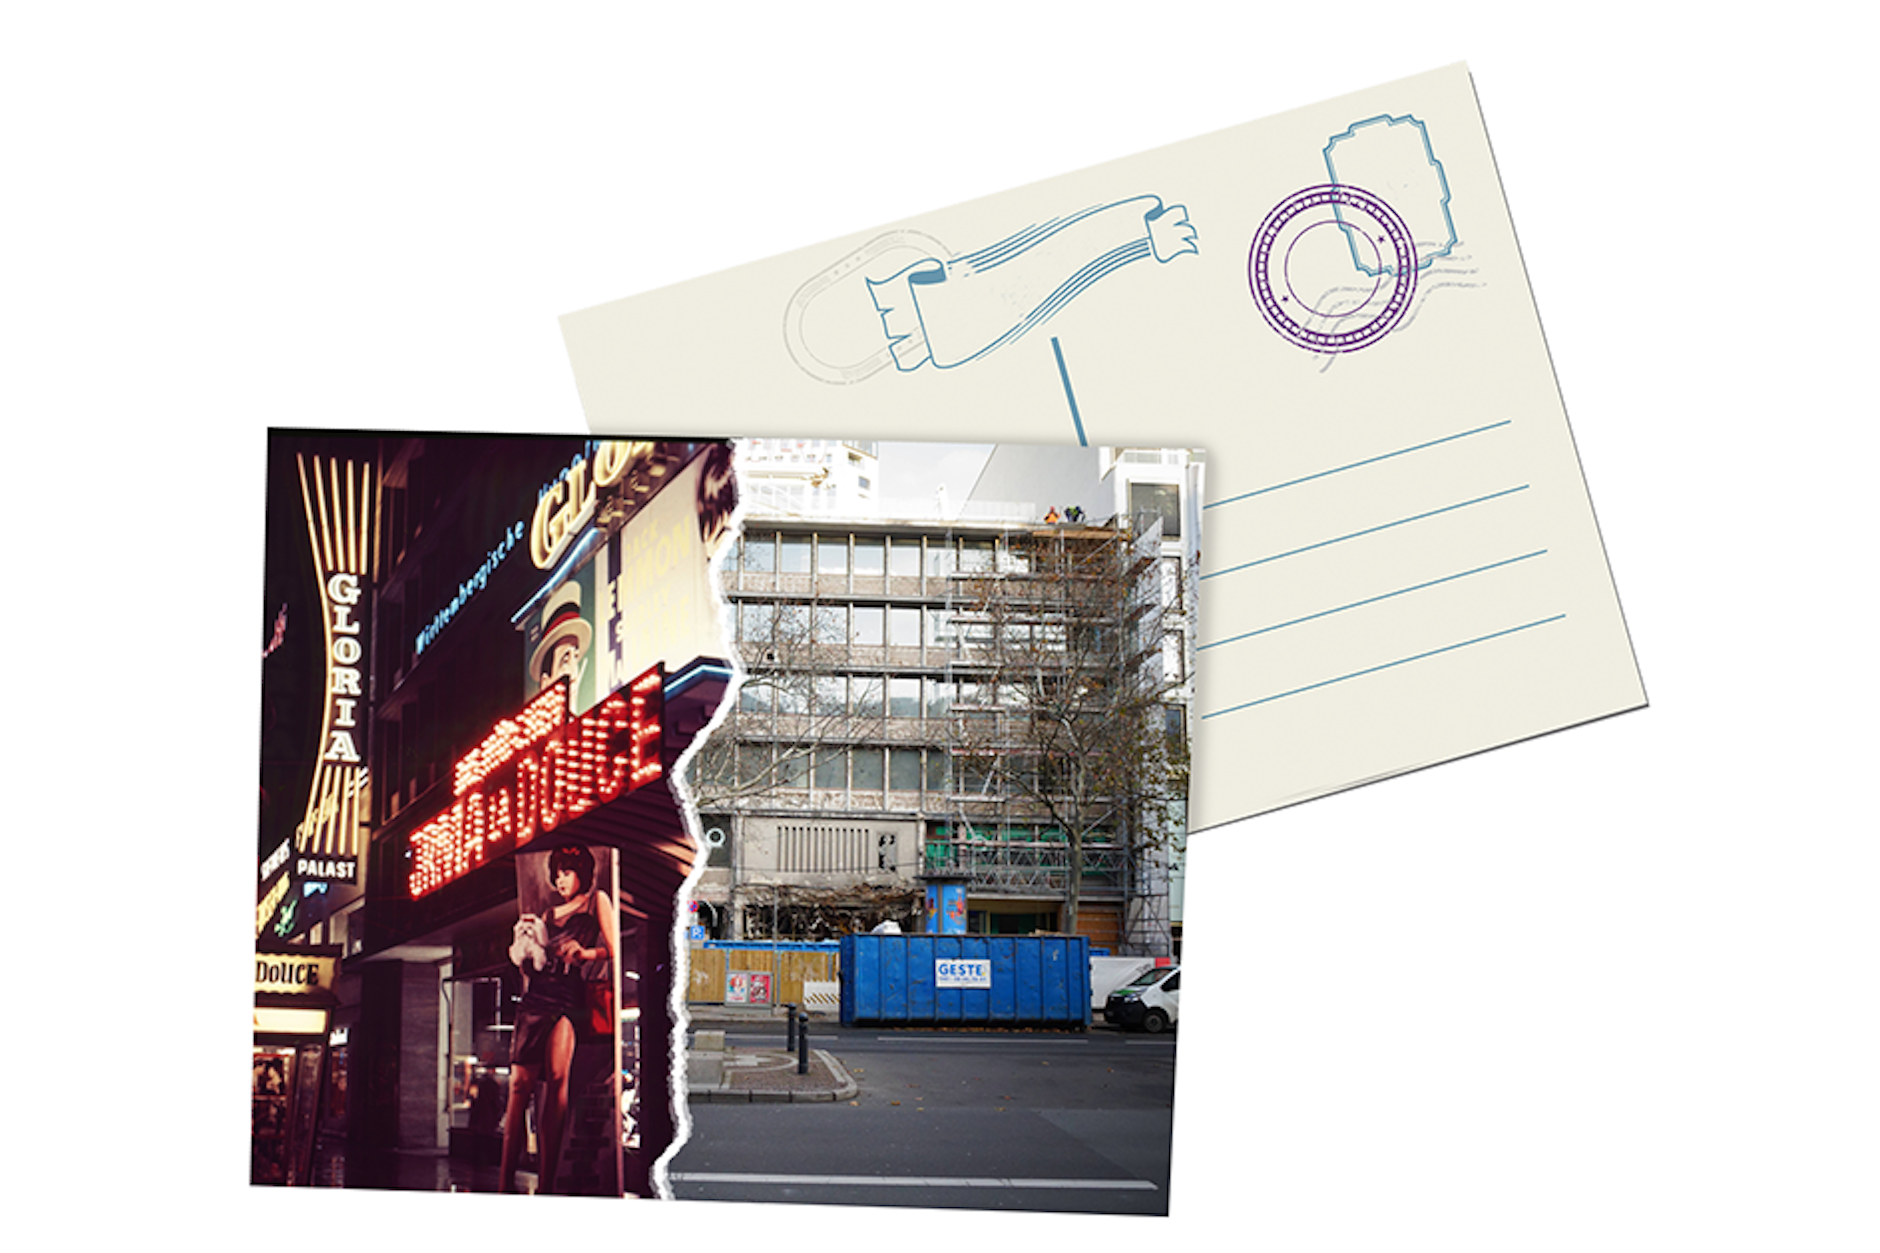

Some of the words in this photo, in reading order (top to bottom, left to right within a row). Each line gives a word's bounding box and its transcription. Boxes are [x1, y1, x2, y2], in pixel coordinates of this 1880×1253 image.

[323, 571, 362, 763] GLORIA
[515, 673, 663, 842] DOUCE
[296, 858, 357, 879] PALAST
